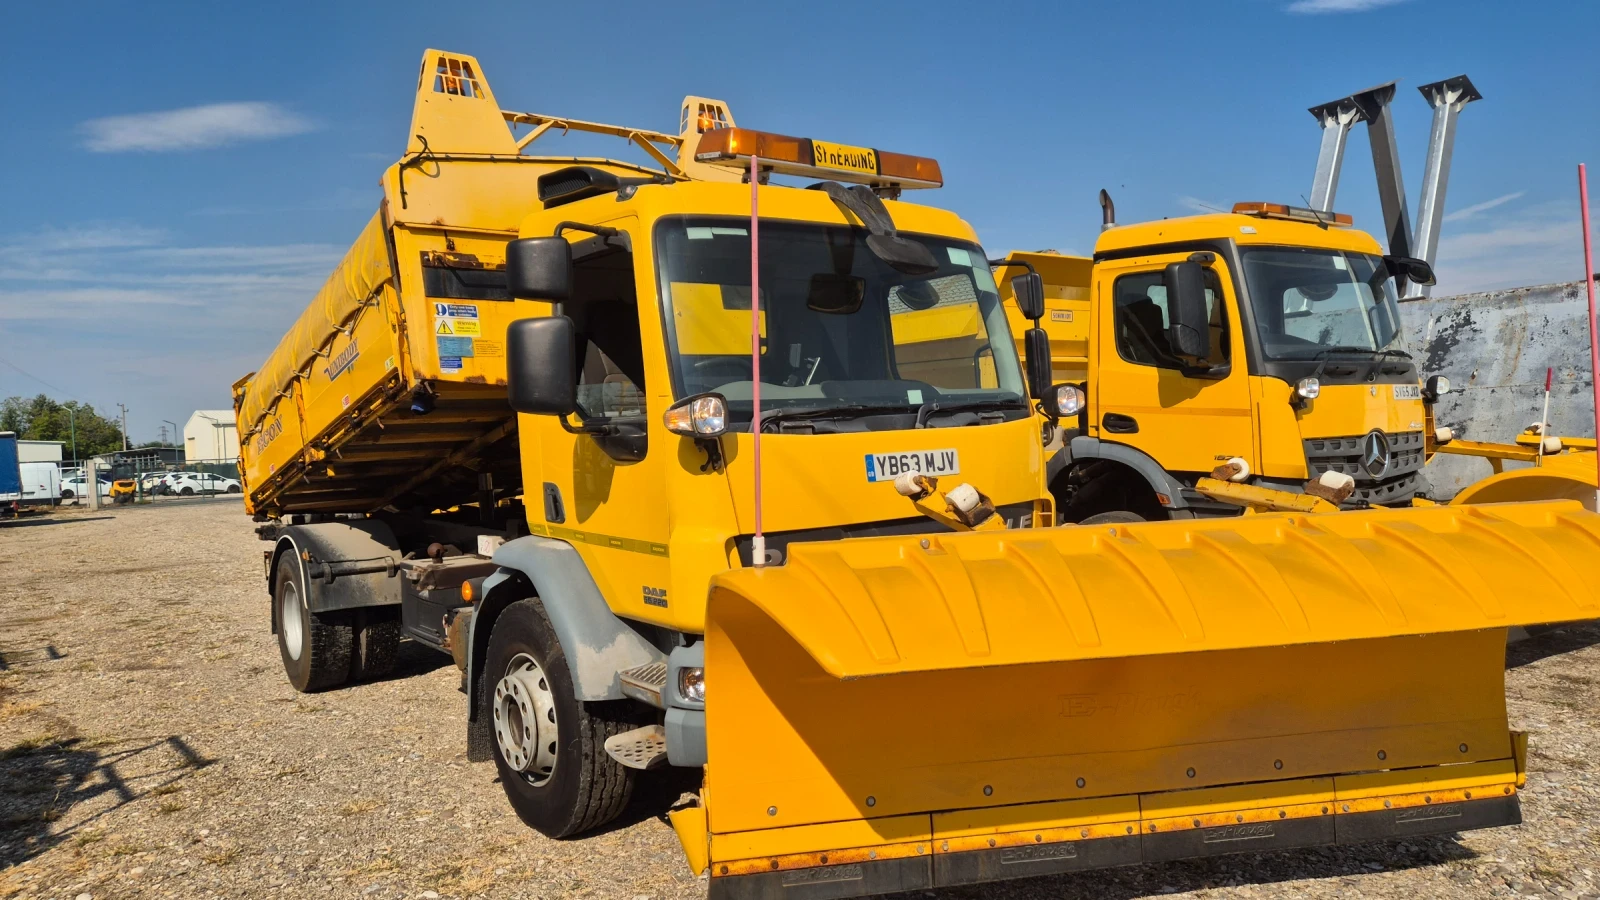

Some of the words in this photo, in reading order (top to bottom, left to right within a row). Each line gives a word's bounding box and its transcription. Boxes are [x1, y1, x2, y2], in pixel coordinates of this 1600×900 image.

[257, 414, 283, 455] ECON
[876, 453, 921, 476] YB63
[925, 451, 954, 472] MJV
[642, 585, 667, 598] DAF
